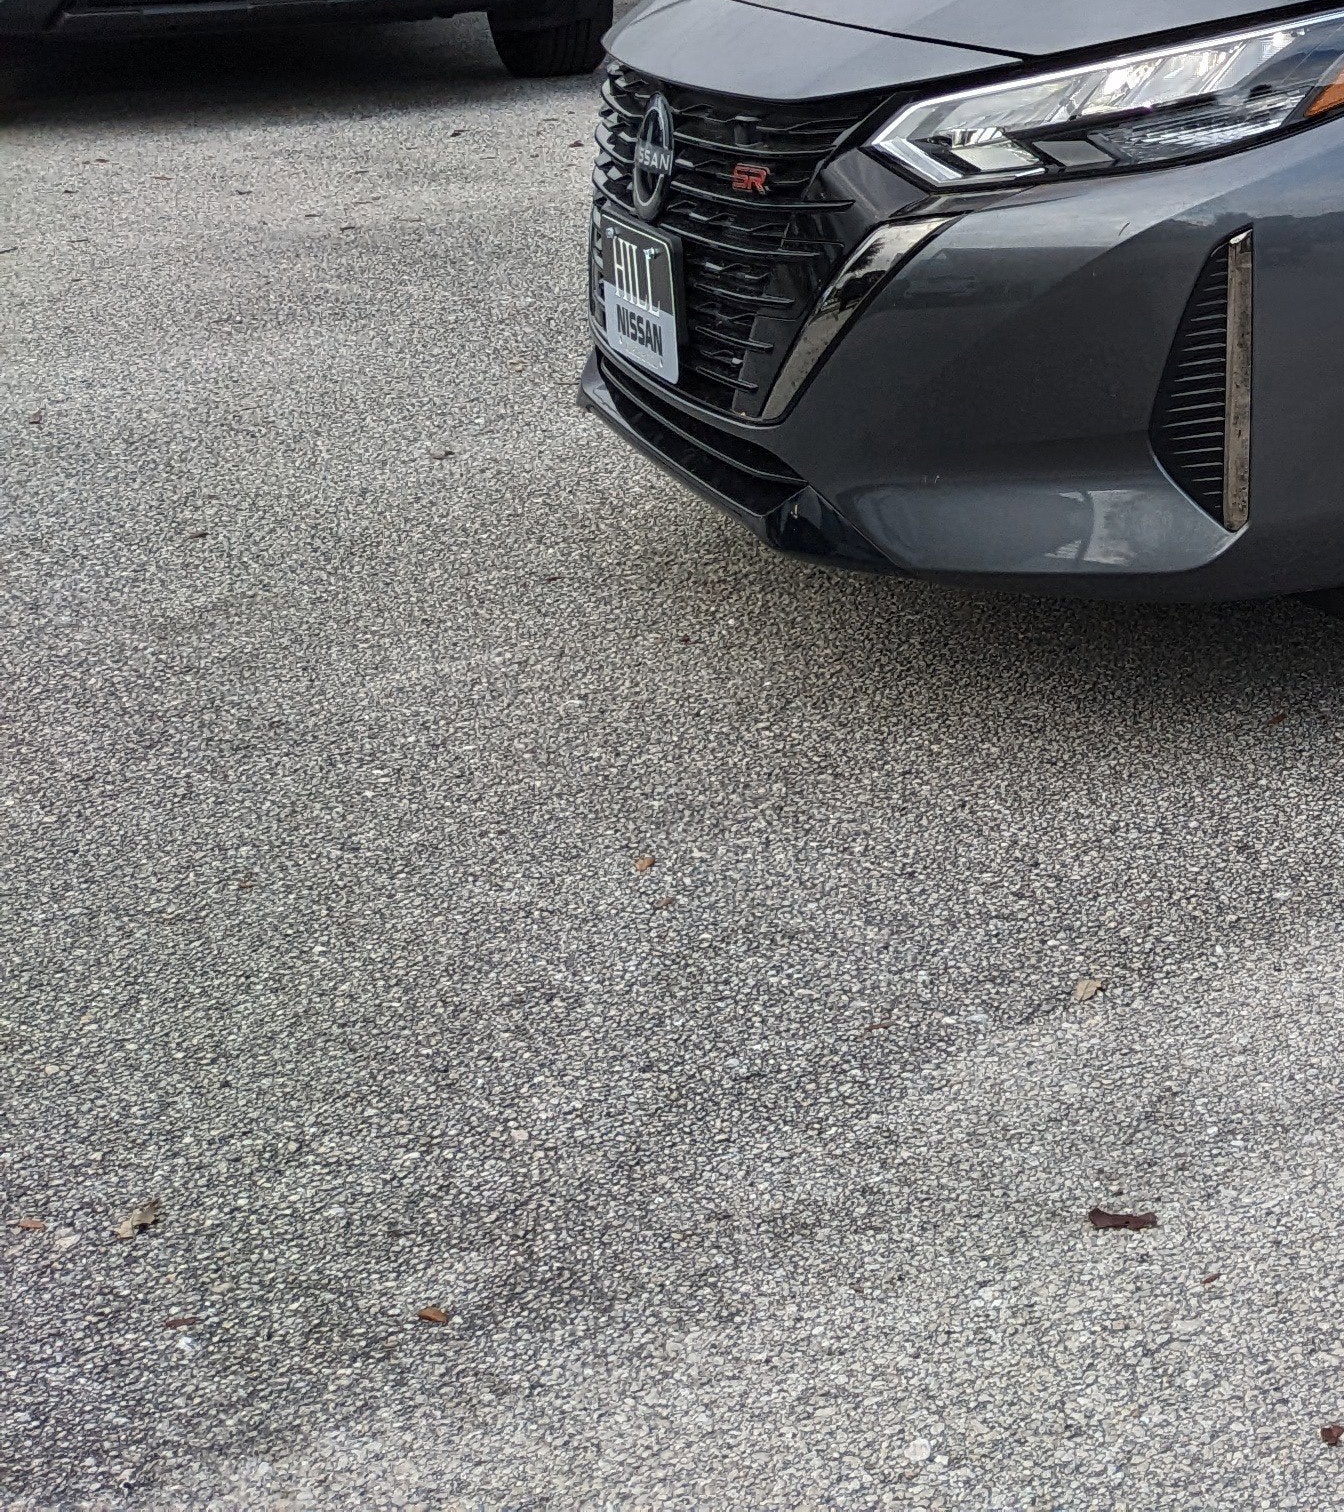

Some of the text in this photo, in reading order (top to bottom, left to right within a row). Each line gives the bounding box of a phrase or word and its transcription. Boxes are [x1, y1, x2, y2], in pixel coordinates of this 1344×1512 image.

[732, 164, 769, 193] SR
[612, 236, 660, 318] HILL
[616, 304, 663, 356] NISSAN
